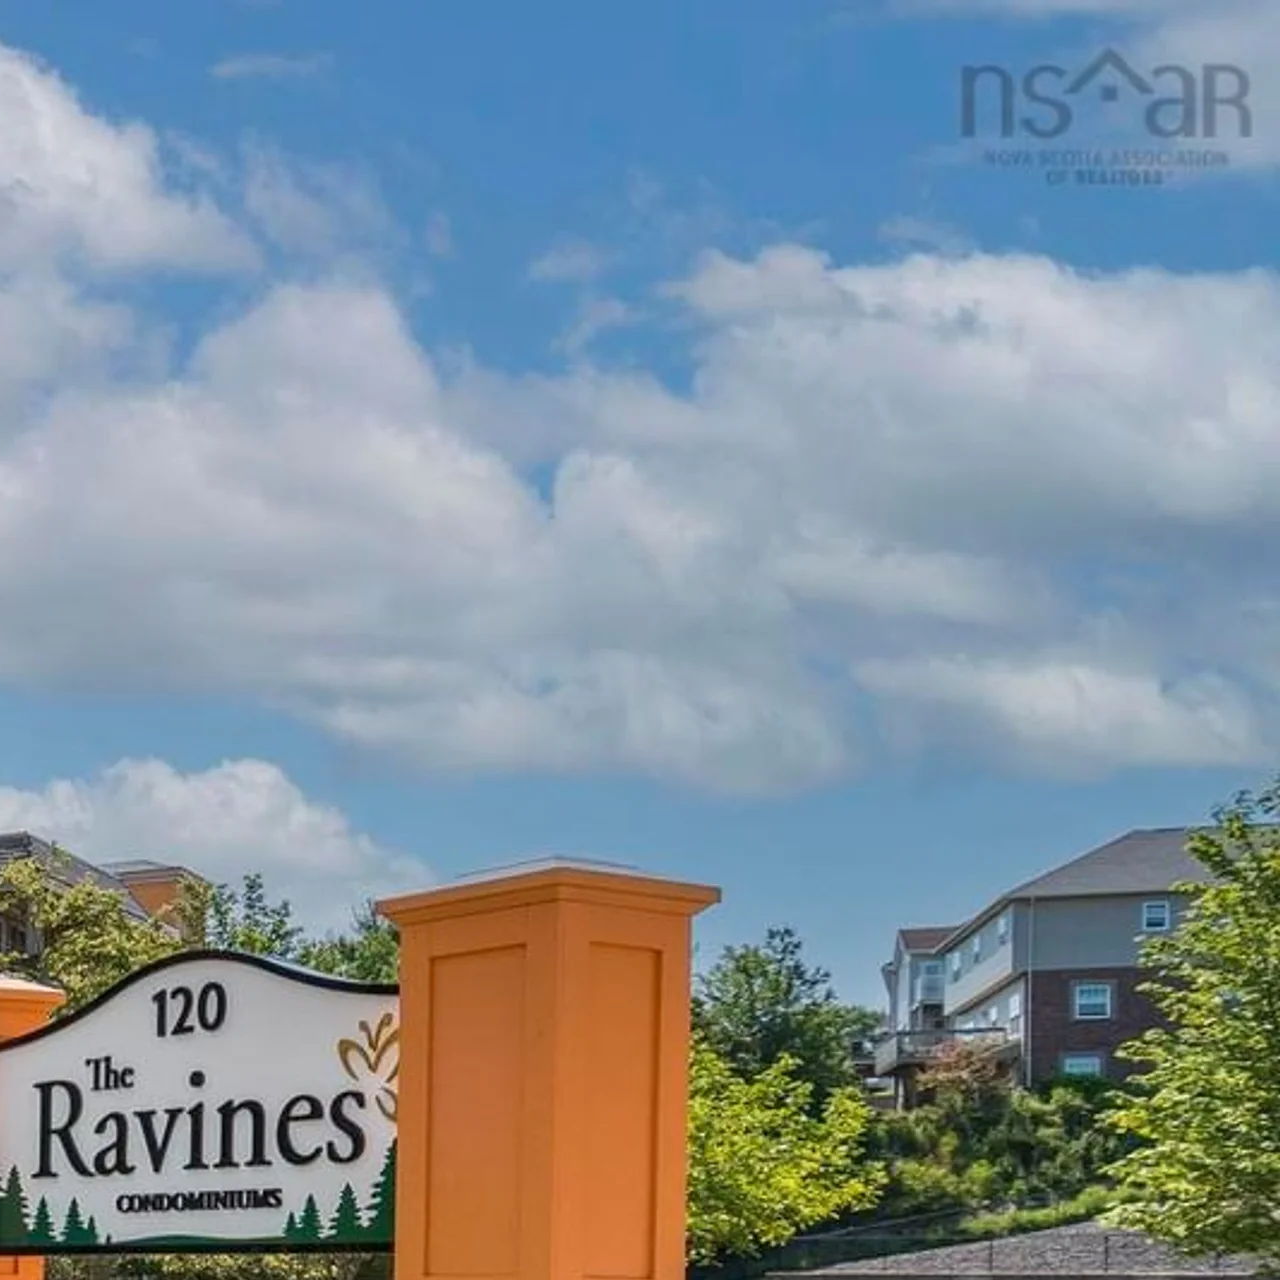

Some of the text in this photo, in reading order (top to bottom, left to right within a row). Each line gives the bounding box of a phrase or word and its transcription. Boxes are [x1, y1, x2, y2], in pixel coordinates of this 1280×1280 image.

[152, 981, 228, 1038] 120
[85, 1056, 135, 1092] The
[31, 1070, 366, 1178] Ravines
[115, 1188, 283, 1213] CONDOMINIUMS
